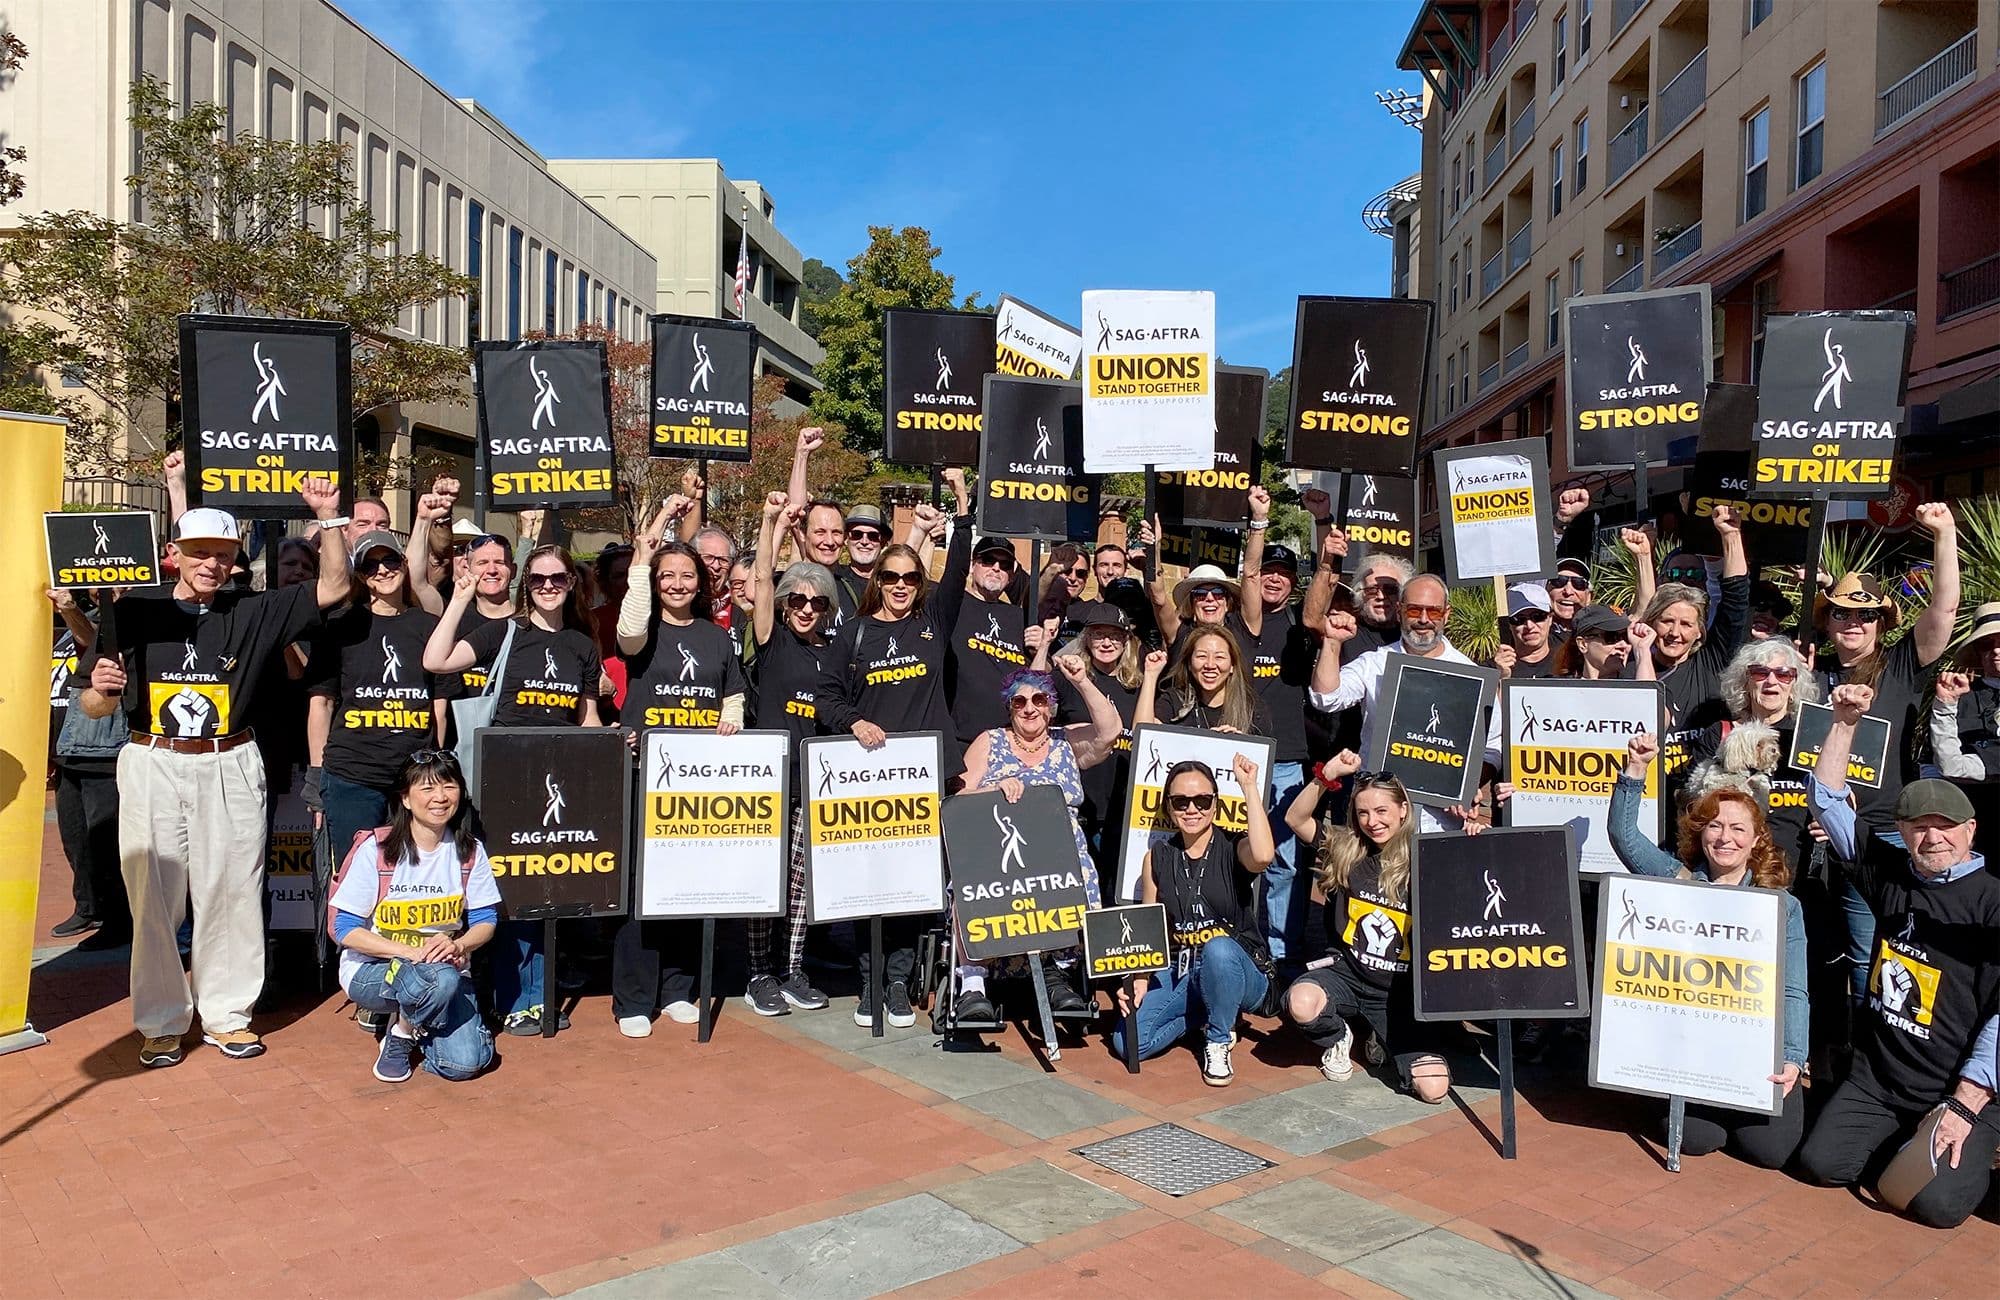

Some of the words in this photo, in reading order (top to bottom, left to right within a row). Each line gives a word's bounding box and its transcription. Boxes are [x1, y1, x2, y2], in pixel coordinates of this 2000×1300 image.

[1097, 356, 1200, 381] UNIONS
[1098, 384, 1136, 395] STAND
[1140, 382, 1200, 394] TOGETHER
[1153, 397, 1201, 405] SUPPORTS
[691, 415, 710, 426] ON
[1300, 410, 1411, 437] STRONG
[1579, 401, 1700, 431] STRONG
[655, 424, 748, 447] STRIKE!
[1812, 443, 1840, 457] ON
[256, 454, 285, 468] ON
[537, 457, 563, 470] ON
[1756, 458, 1893, 483] STRIKE!
[491, 469, 613, 496] STRIKE!
[990, 479, 1089, 503] STRONG
[1456, 491, 1530, 511] UNIONS
[1457, 512, 1485, 521] STAND
[1487, 508, 1530, 518] TOGETHER
[59, 566, 151, 584] STRONG
[967, 638, 1025, 665] STRONG
[865, 663, 927, 686] STRONG
[383, 700, 404, 710] ON
[680, 698, 695, 709] ON
[1390, 742, 1463, 768] STRONG
[1520, 749, 1629, 778] UNION
[1797, 751, 1876, 782] STNG
[1520, 777, 1567, 791] STAND
[655, 795, 773, 820] UNIONS
[819, 796, 931, 827] UNIONS
[655, 823, 700, 835] STAND
[702, 823, 772, 835] TOGETHER
[820, 829, 863, 842] STAND
[865, 823, 931, 839] TOGETHER
[719, 839, 773, 848] SUPPORTS
[882, 839, 933, 850] SUPPORTS
[490, 851, 615, 878] STRONG
[1011, 897, 1036, 911] ON
[380, 905, 400, 925] ON
[966, 903, 1086, 943] STRIKE!
[1094, 952, 1164, 973] STRONG
[1360, 953, 1409, 973] STRIKE!
[1428, 945, 1567, 972] STRONG
[1616, 948, 1763, 993] UNIONS
[1615, 980, 1670, 999] STAND
[1673, 987, 1763, 1013] TOGETHER
[1694, 1011, 1764, 1028] SUPPORTS
